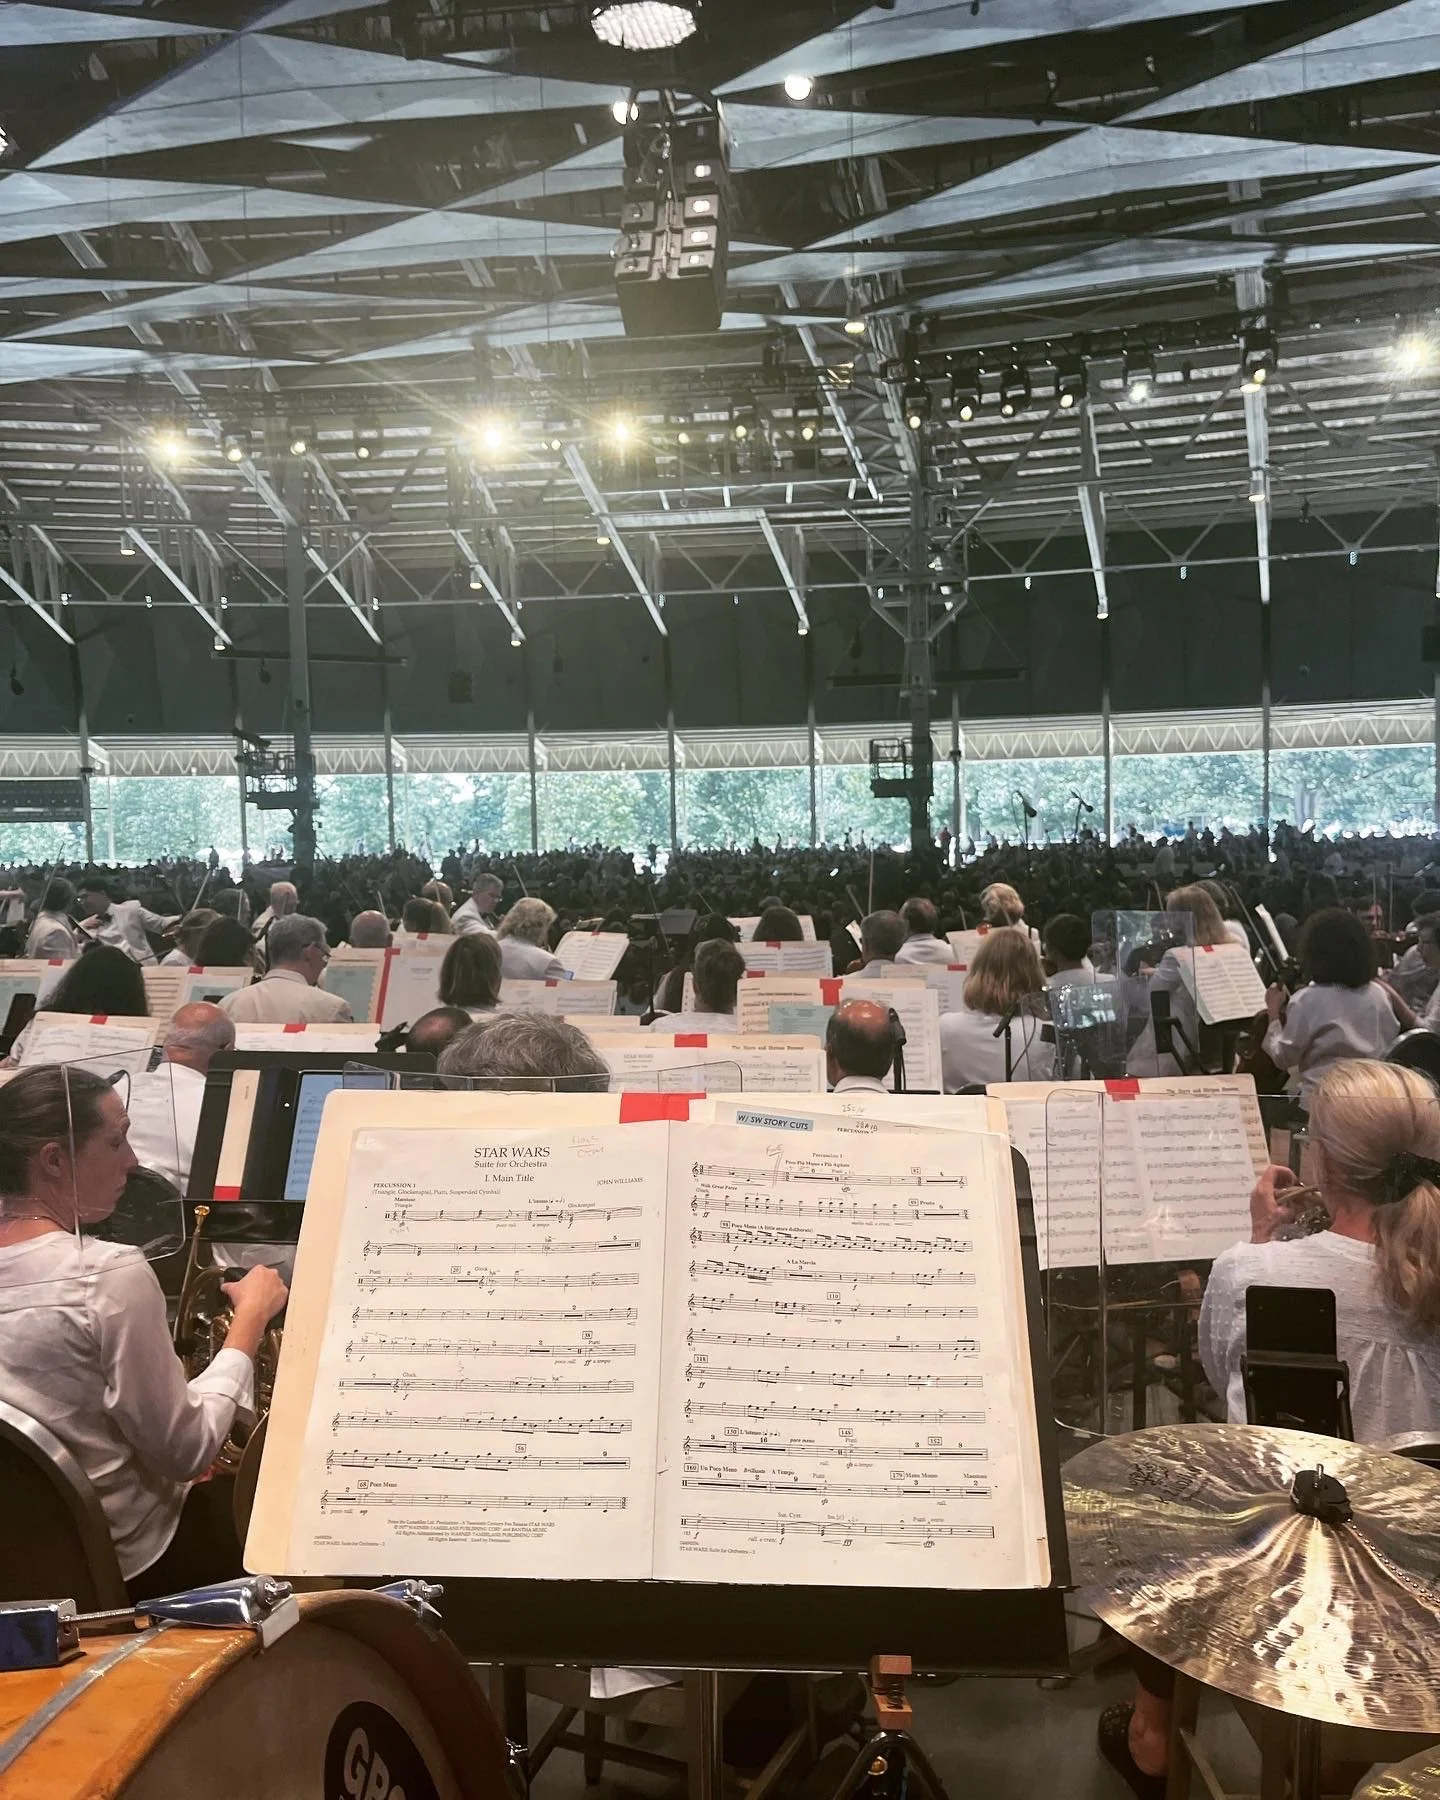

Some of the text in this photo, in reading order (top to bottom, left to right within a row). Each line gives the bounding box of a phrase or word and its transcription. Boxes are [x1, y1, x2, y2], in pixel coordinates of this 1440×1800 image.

[737, 1114, 809, 1130] W/ SW STORY CUTS
[474, 1146, 551, 1158] STAR WARS
[474, 1160, 548, 1168] Suite for Orchestra
[484, 1173, 535, 1183] I. Main Title
[597, 1177, 643, 1187] JOHN WILLIAMS
